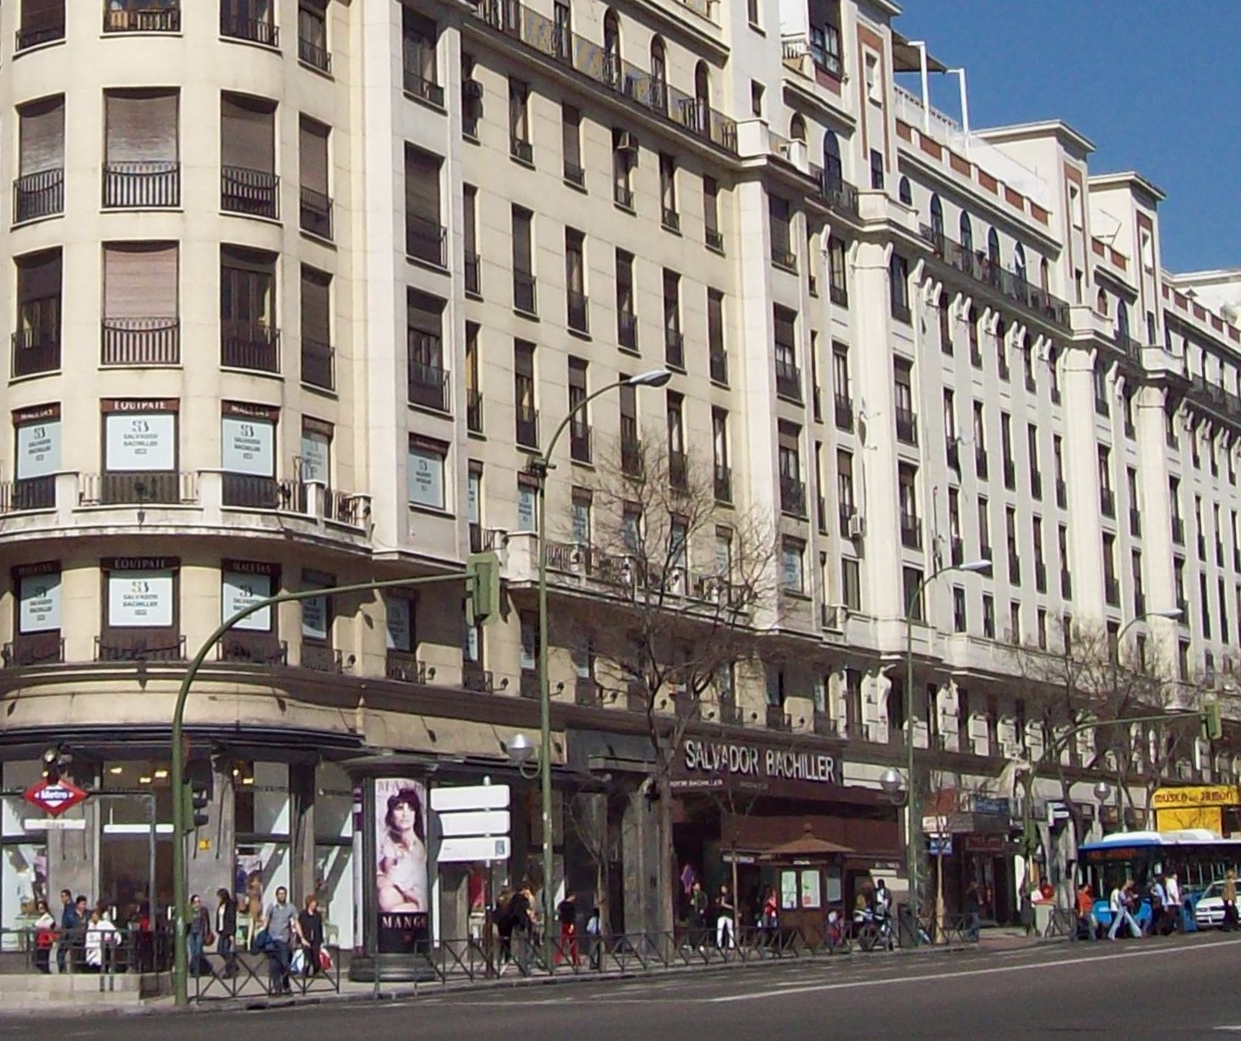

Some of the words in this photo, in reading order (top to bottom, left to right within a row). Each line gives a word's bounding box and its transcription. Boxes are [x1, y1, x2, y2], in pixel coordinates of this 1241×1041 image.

[685, 739, 760, 776] SALVADOR
[765, 749, 836, 782] BACHILLER
[40, 789, 69, 800] Metro
